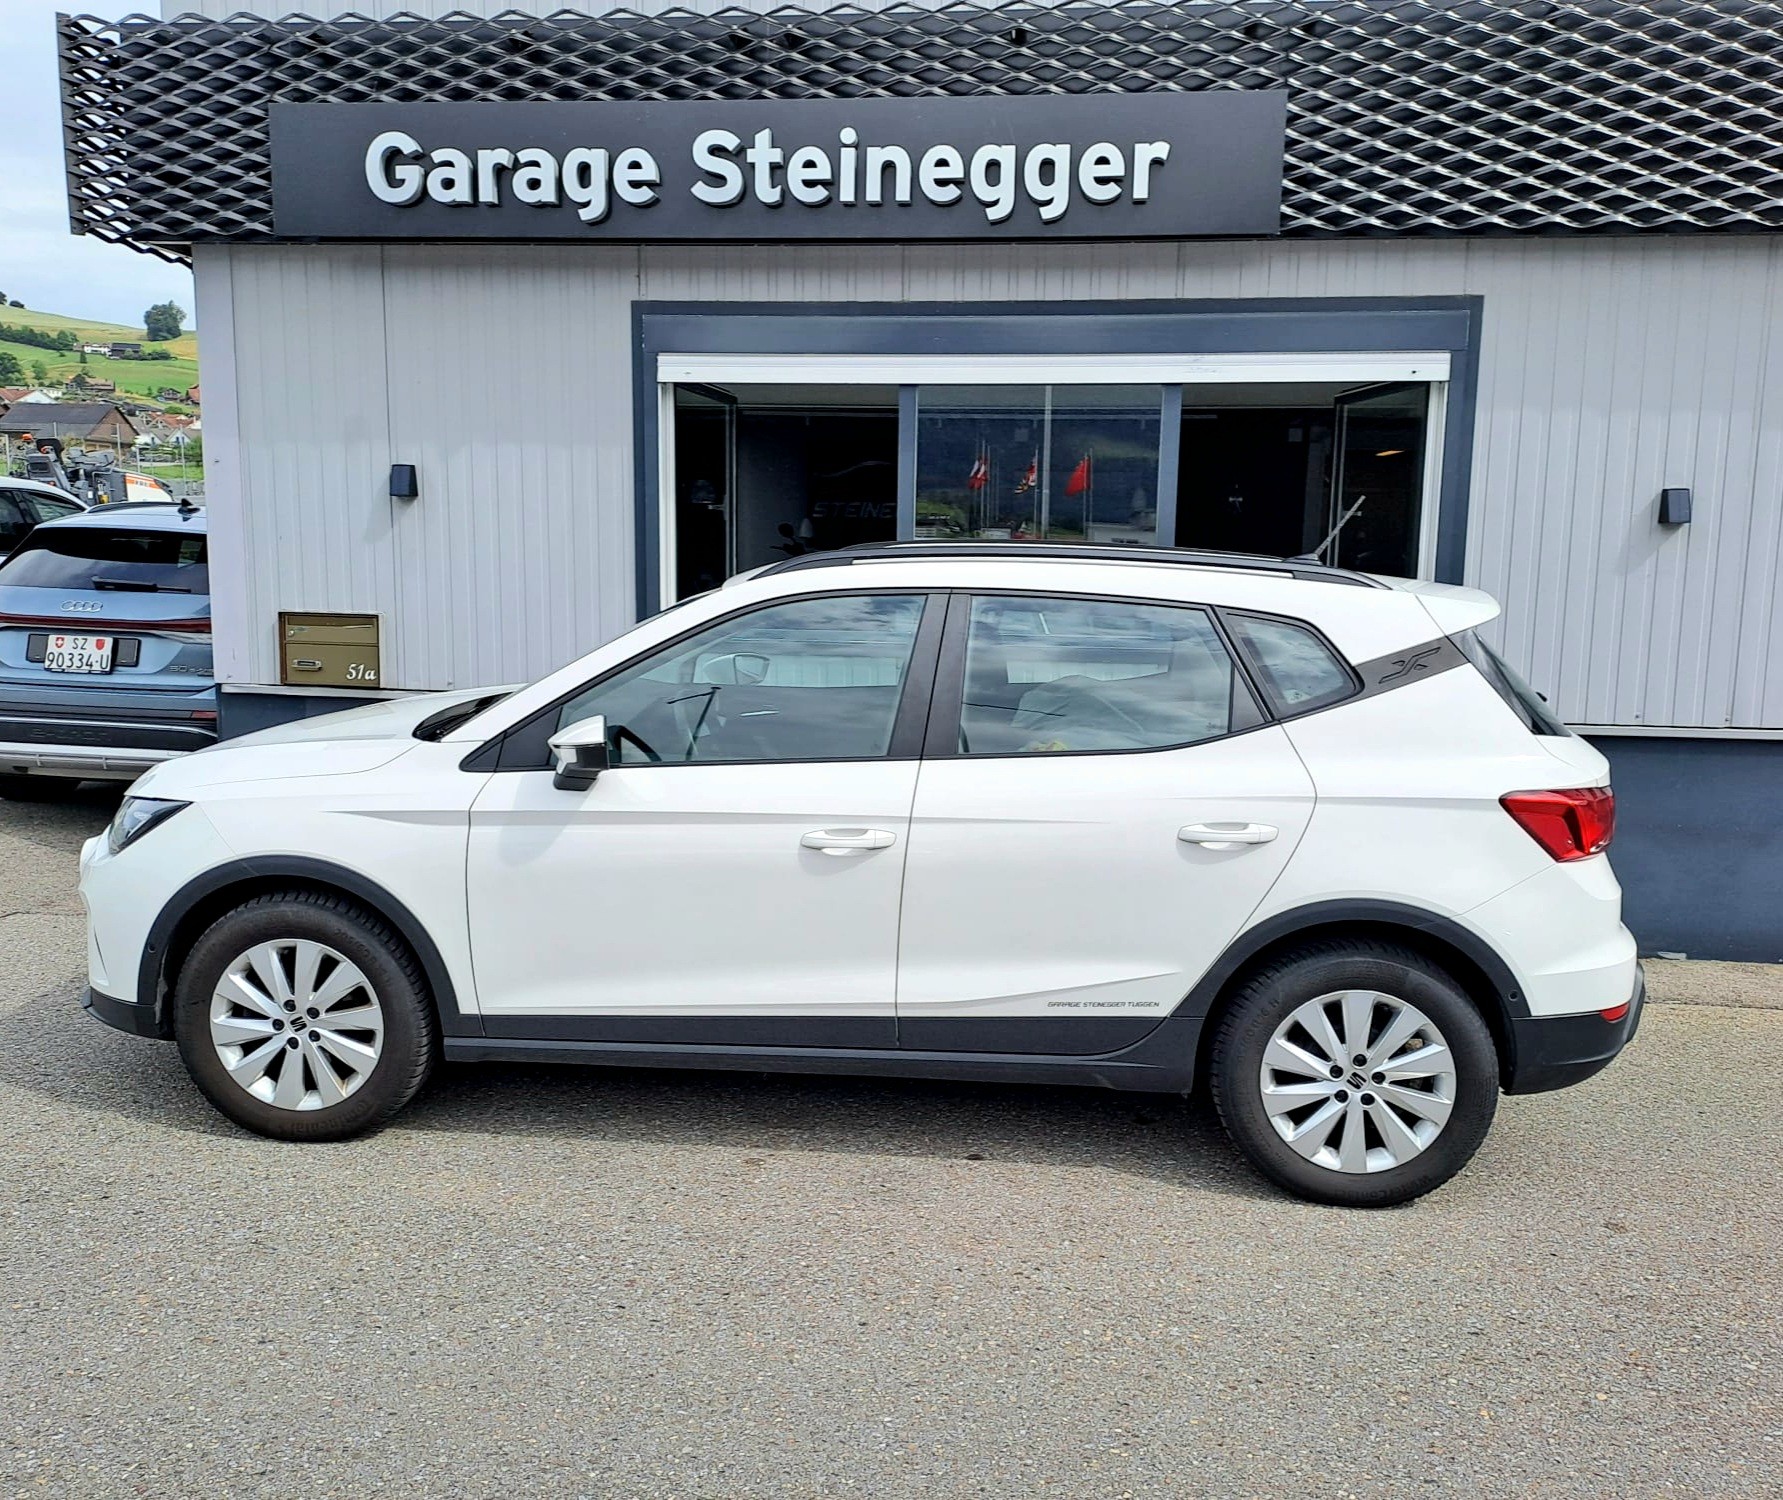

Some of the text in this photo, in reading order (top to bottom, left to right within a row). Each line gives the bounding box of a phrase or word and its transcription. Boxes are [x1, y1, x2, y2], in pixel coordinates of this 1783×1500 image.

[364, 127, 1171, 222] Garage Steinegger
[72, 637, 88, 650] SZ
[346, 663, 377, 680] 51a
